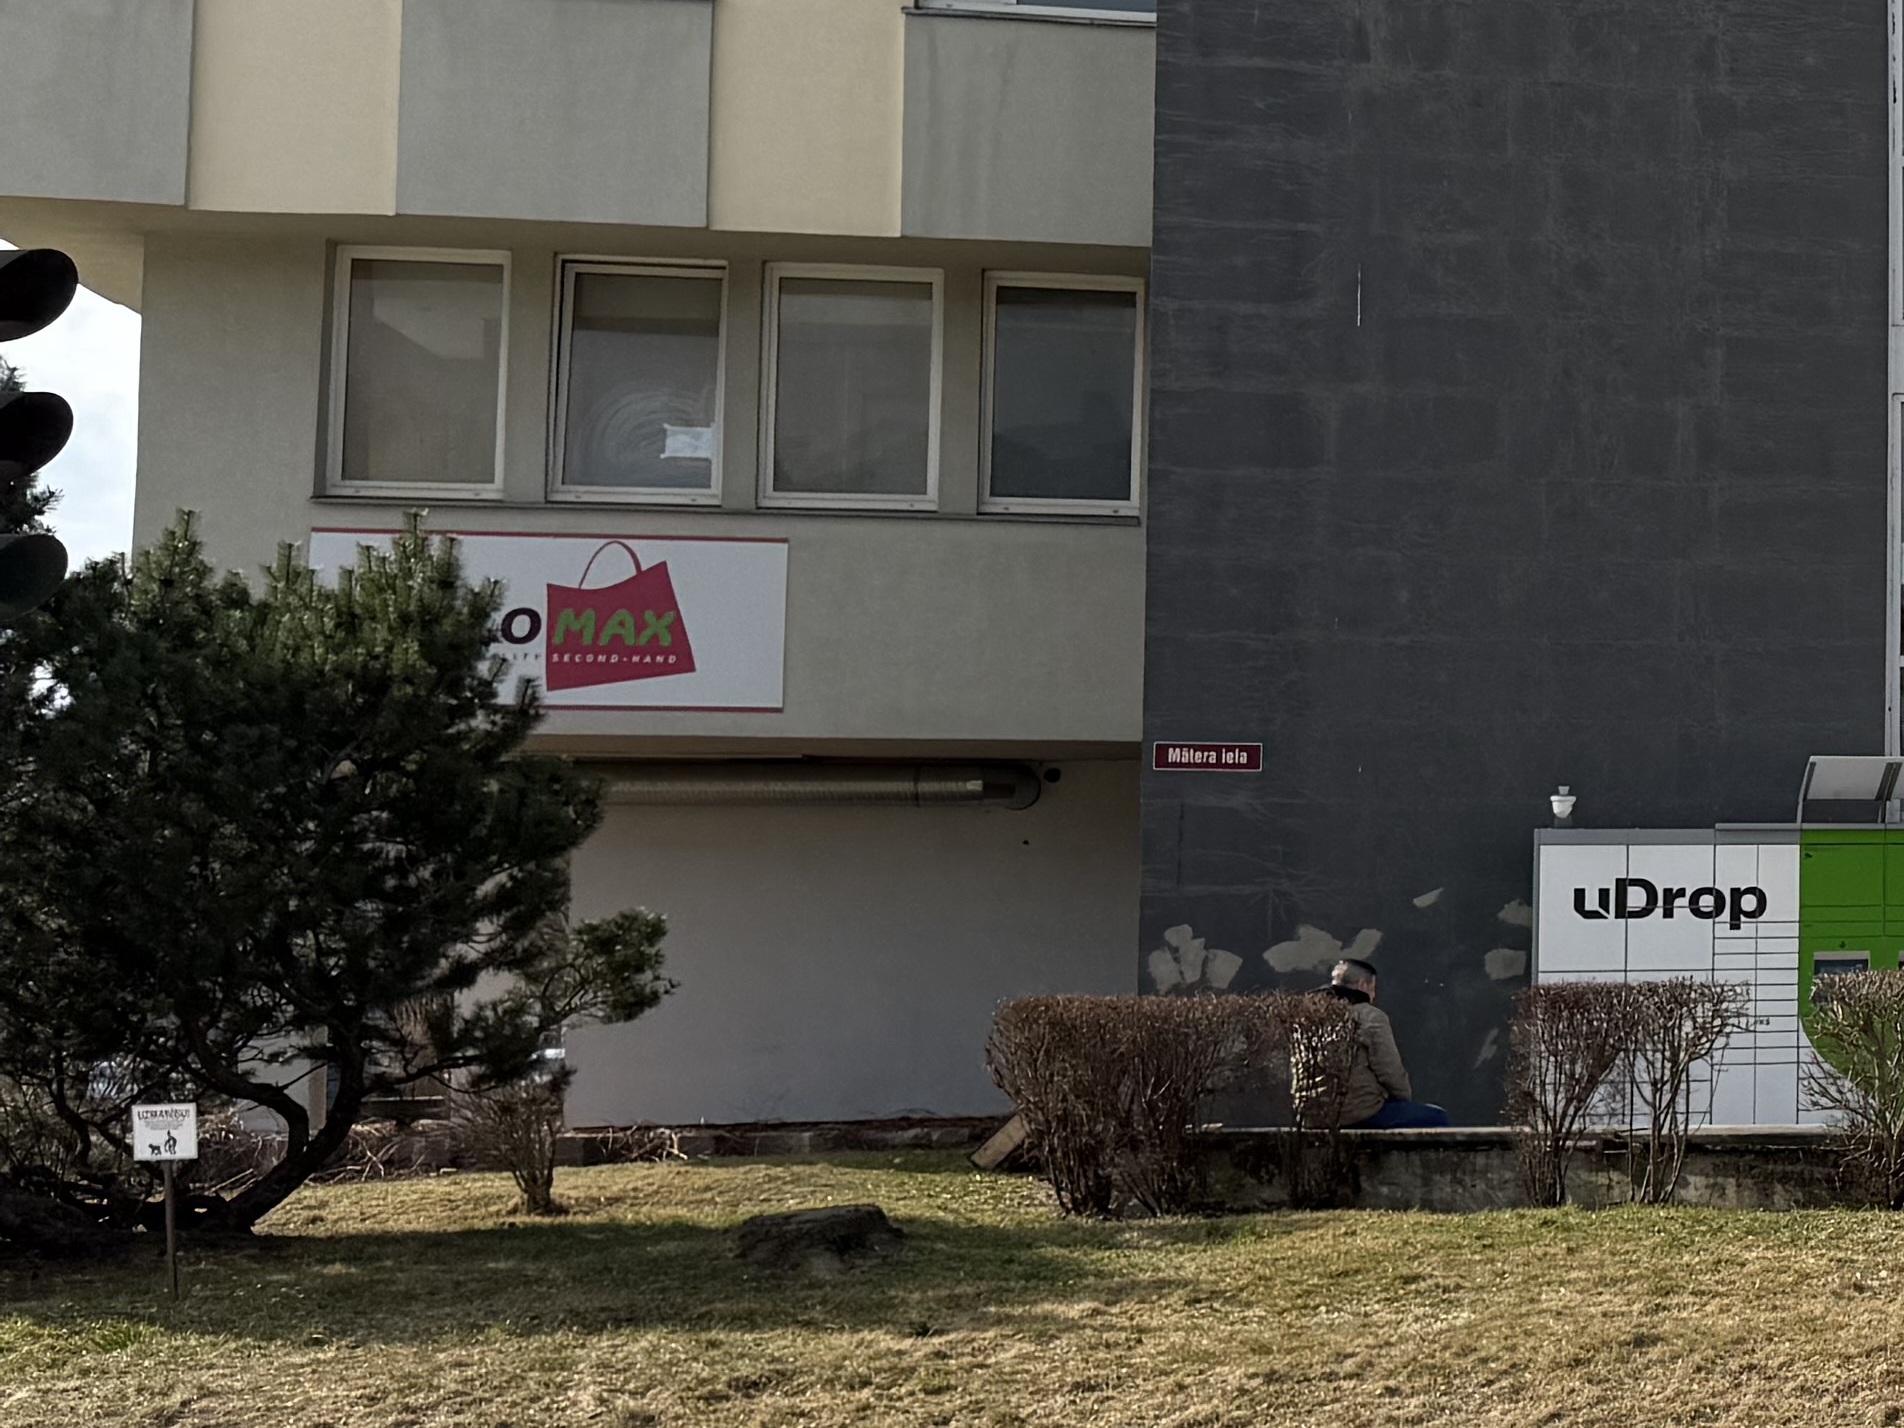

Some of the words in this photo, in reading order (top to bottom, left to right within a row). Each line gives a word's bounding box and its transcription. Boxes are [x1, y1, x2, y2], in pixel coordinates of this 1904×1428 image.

[1167, 747, 1217, 764] Mātera
[1221, 747, 1248, 764] iela
[1573, 877, 1768, 931] uDrop
